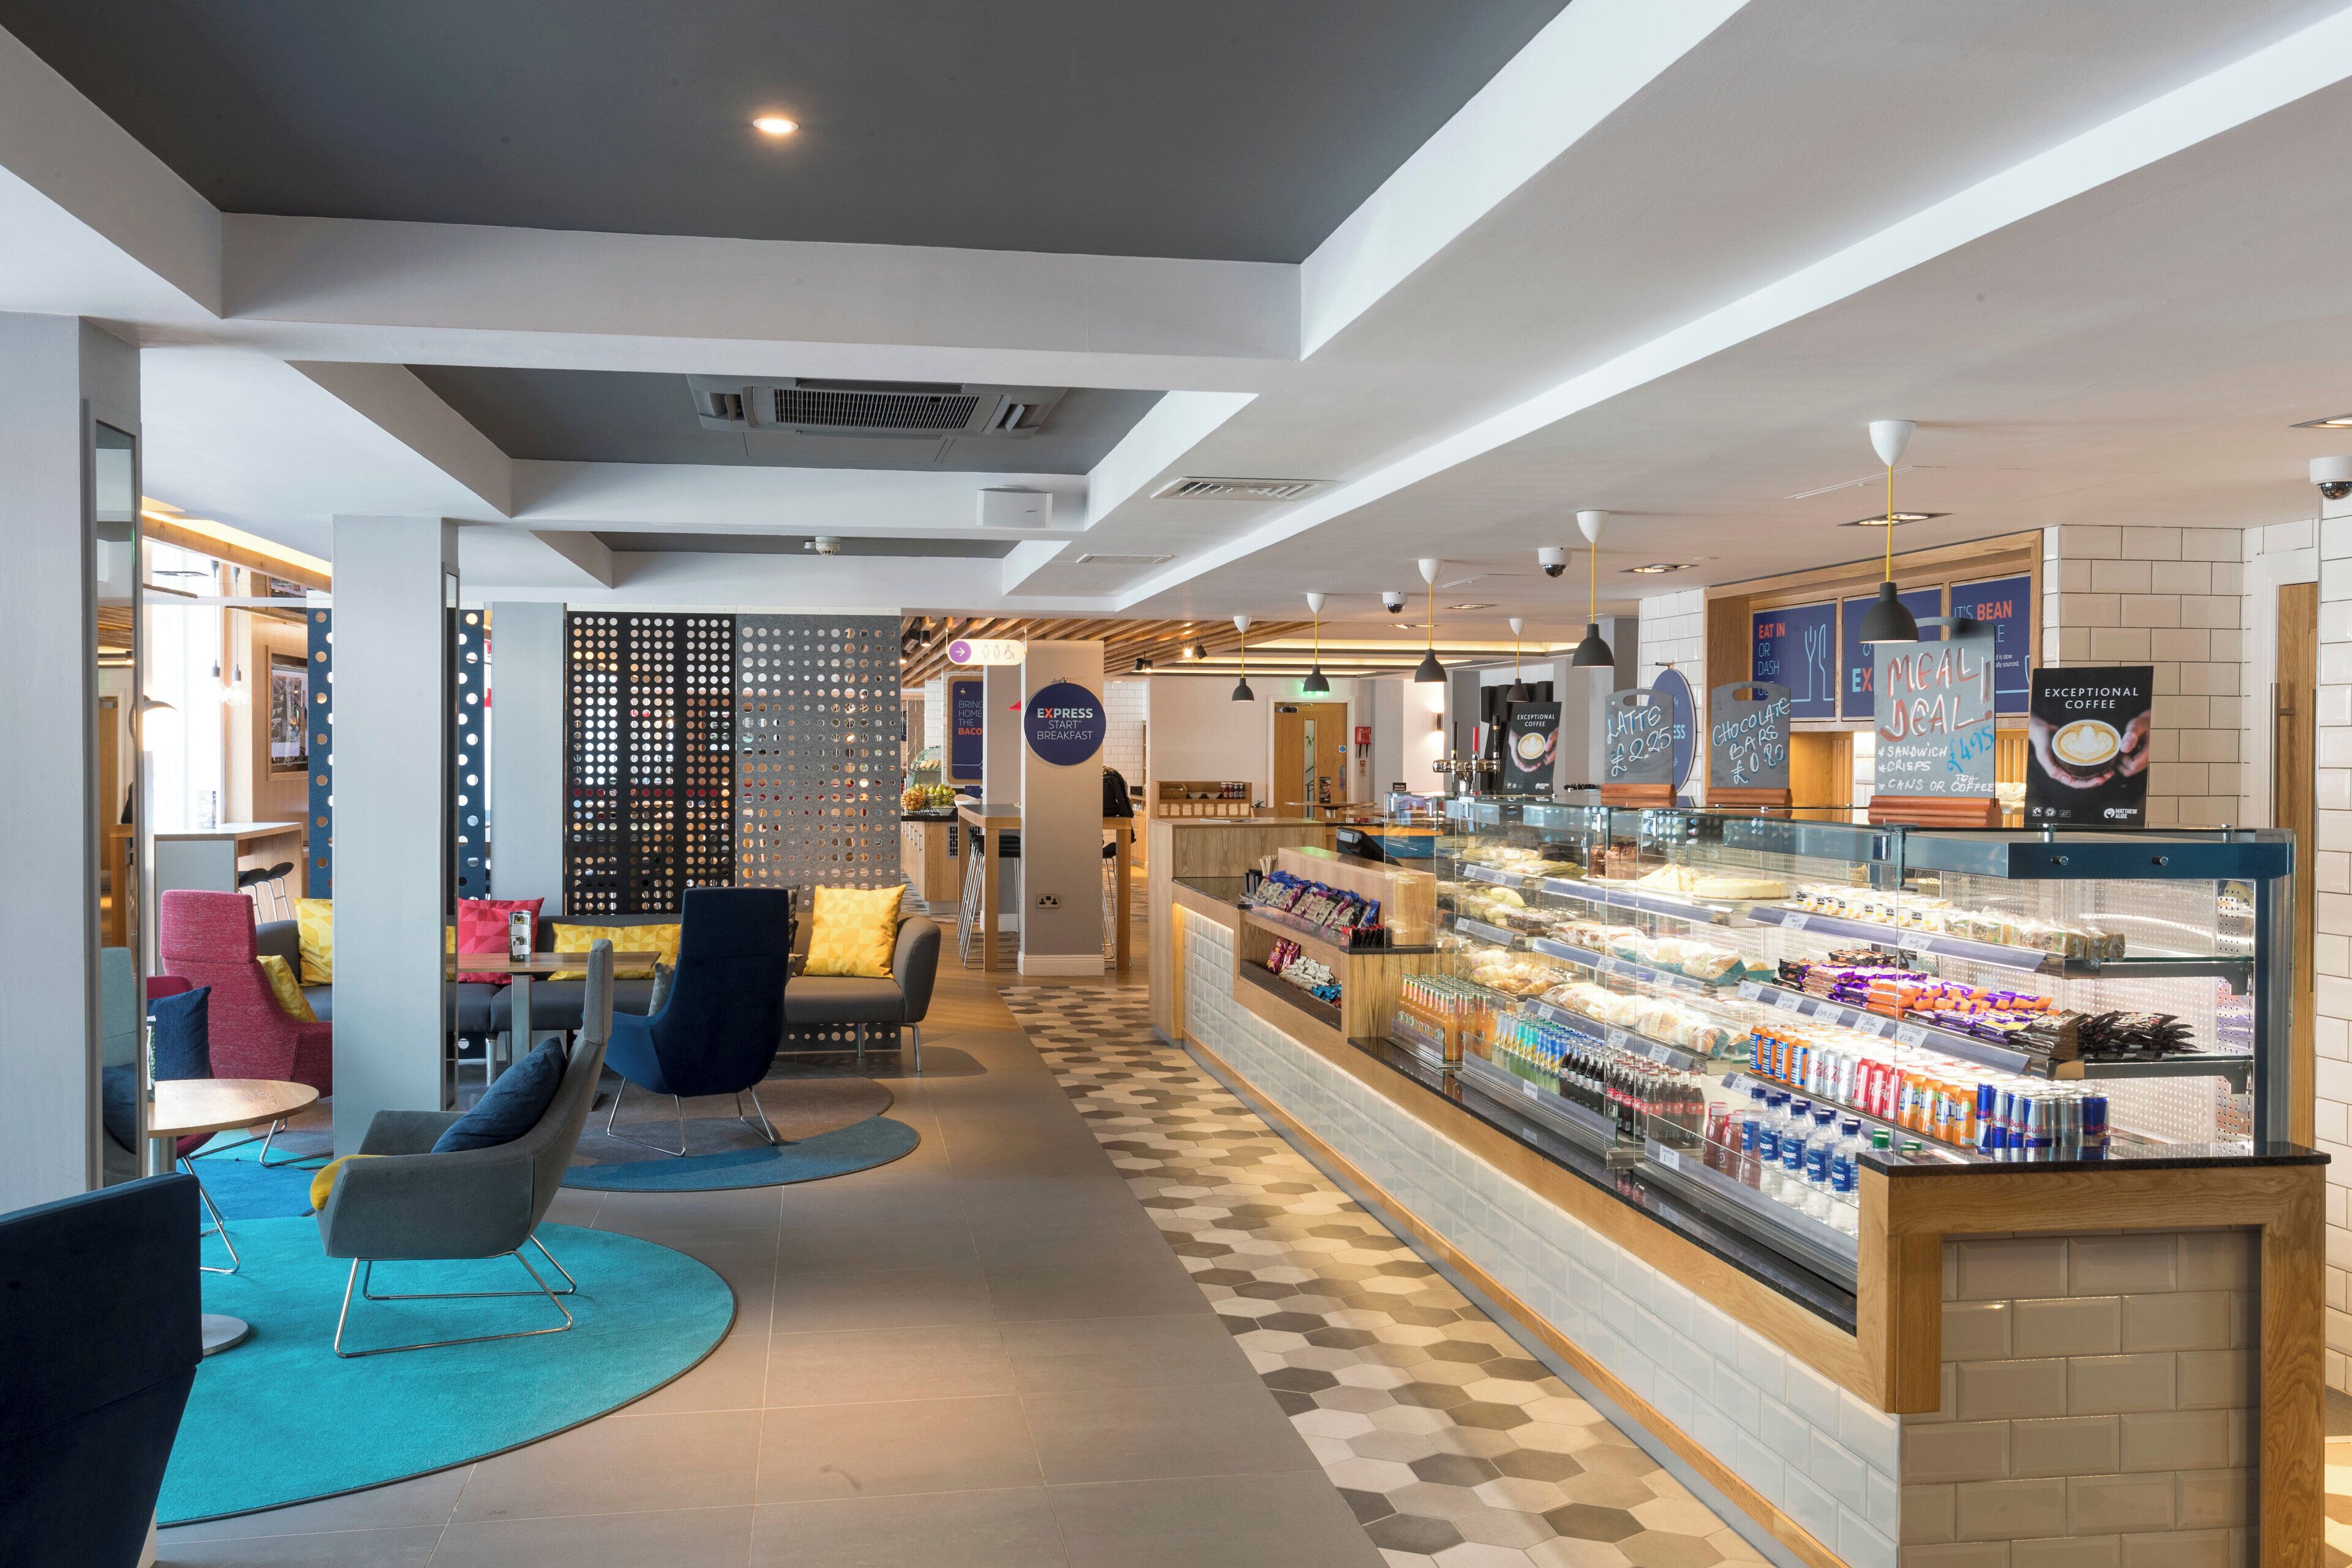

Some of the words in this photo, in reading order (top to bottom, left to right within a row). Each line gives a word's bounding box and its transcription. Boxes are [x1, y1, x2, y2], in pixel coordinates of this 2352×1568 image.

[1977, 600, 2012, 621] BEAN
[1758, 624, 1774, 639] EAT
[1776, 622, 1785, 637] IN
[1758, 643, 1770, 657] OR
[1758, 660, 1780, 676] DASH
[1887, 647, 1981, 699] MEAL
[2045, 687, 2139, 697] EXCEPTIONAL
[2065, 700, 2116, 709] COFFEE
[1037, 708, 1093, 718] EXPRESS
[1607, 706, 1660, 744] LATTE
[1713, 698, 1790, 747] CHOCOLATE
[1037, 731, 1093, 740] BREAKFAST
[1729, 725, 1778, 760] BARS
[1611, 726, 1672, 777] £2.25
[1947, 725, 1994, 773] £4.95
[1887, 759, 1932, 772] CRISPS
[1888, 778, 1923, 791] CANS
[1930, 780, 1946, 793] OR
[1950, 783, 1994, 792] COFFEE
[1956, 774, 1979, 783] TEA
